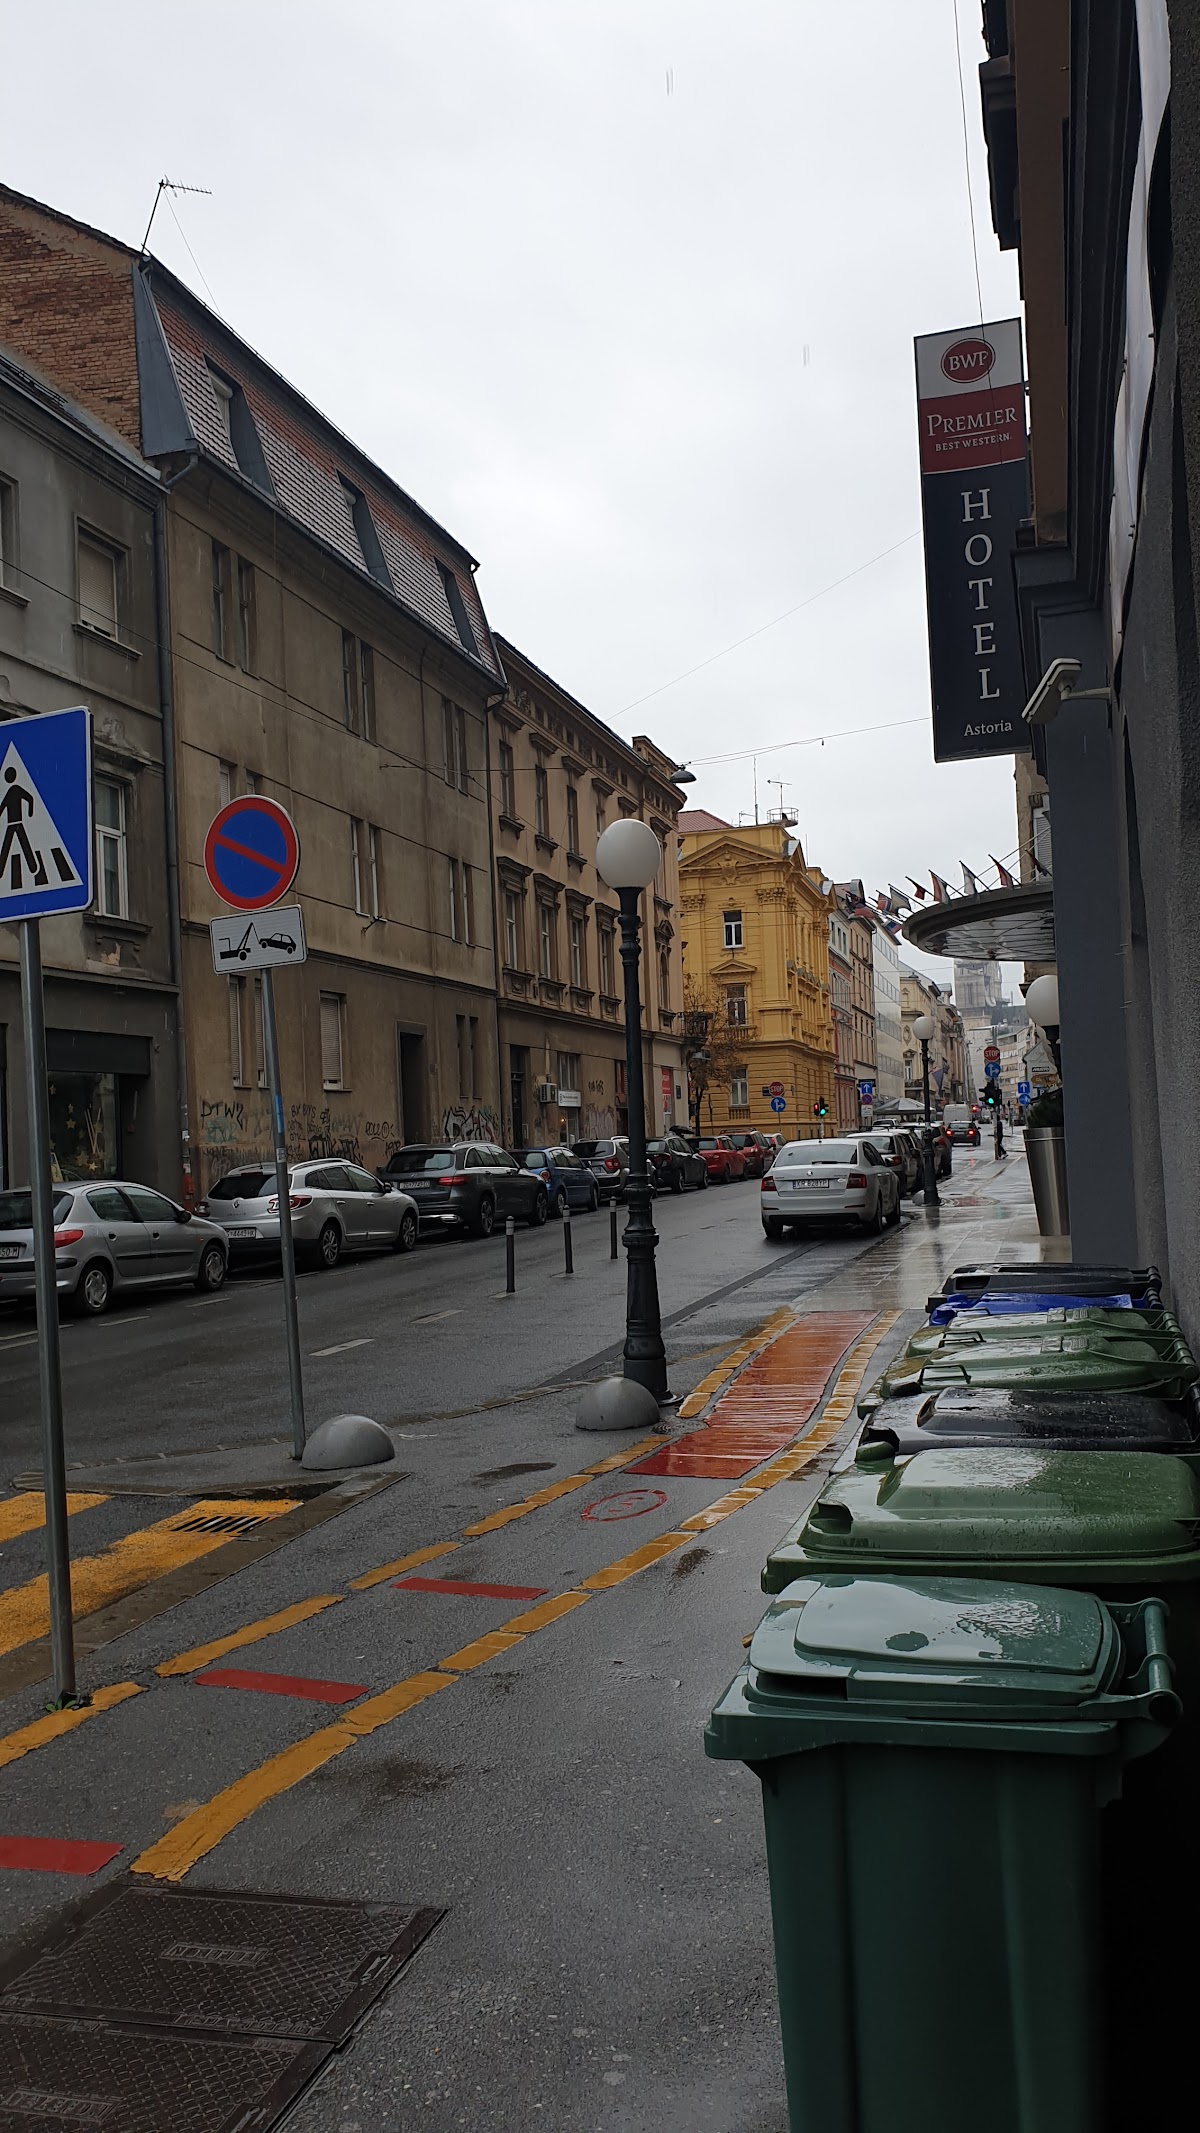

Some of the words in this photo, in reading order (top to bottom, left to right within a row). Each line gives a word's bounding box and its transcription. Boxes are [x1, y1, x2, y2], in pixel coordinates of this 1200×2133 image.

[949, 350, 988, 371] BWP
[926, 407, 1018, 437] PREMIER
[935, 441, 960, 452] BEST
[960, 488, 1000, 700] HOTEL
[963, 719, 1013, 737] Astoria
[984, 1050, 999, 1058] STOP
[770, 1085, 784, 1093] STOP
